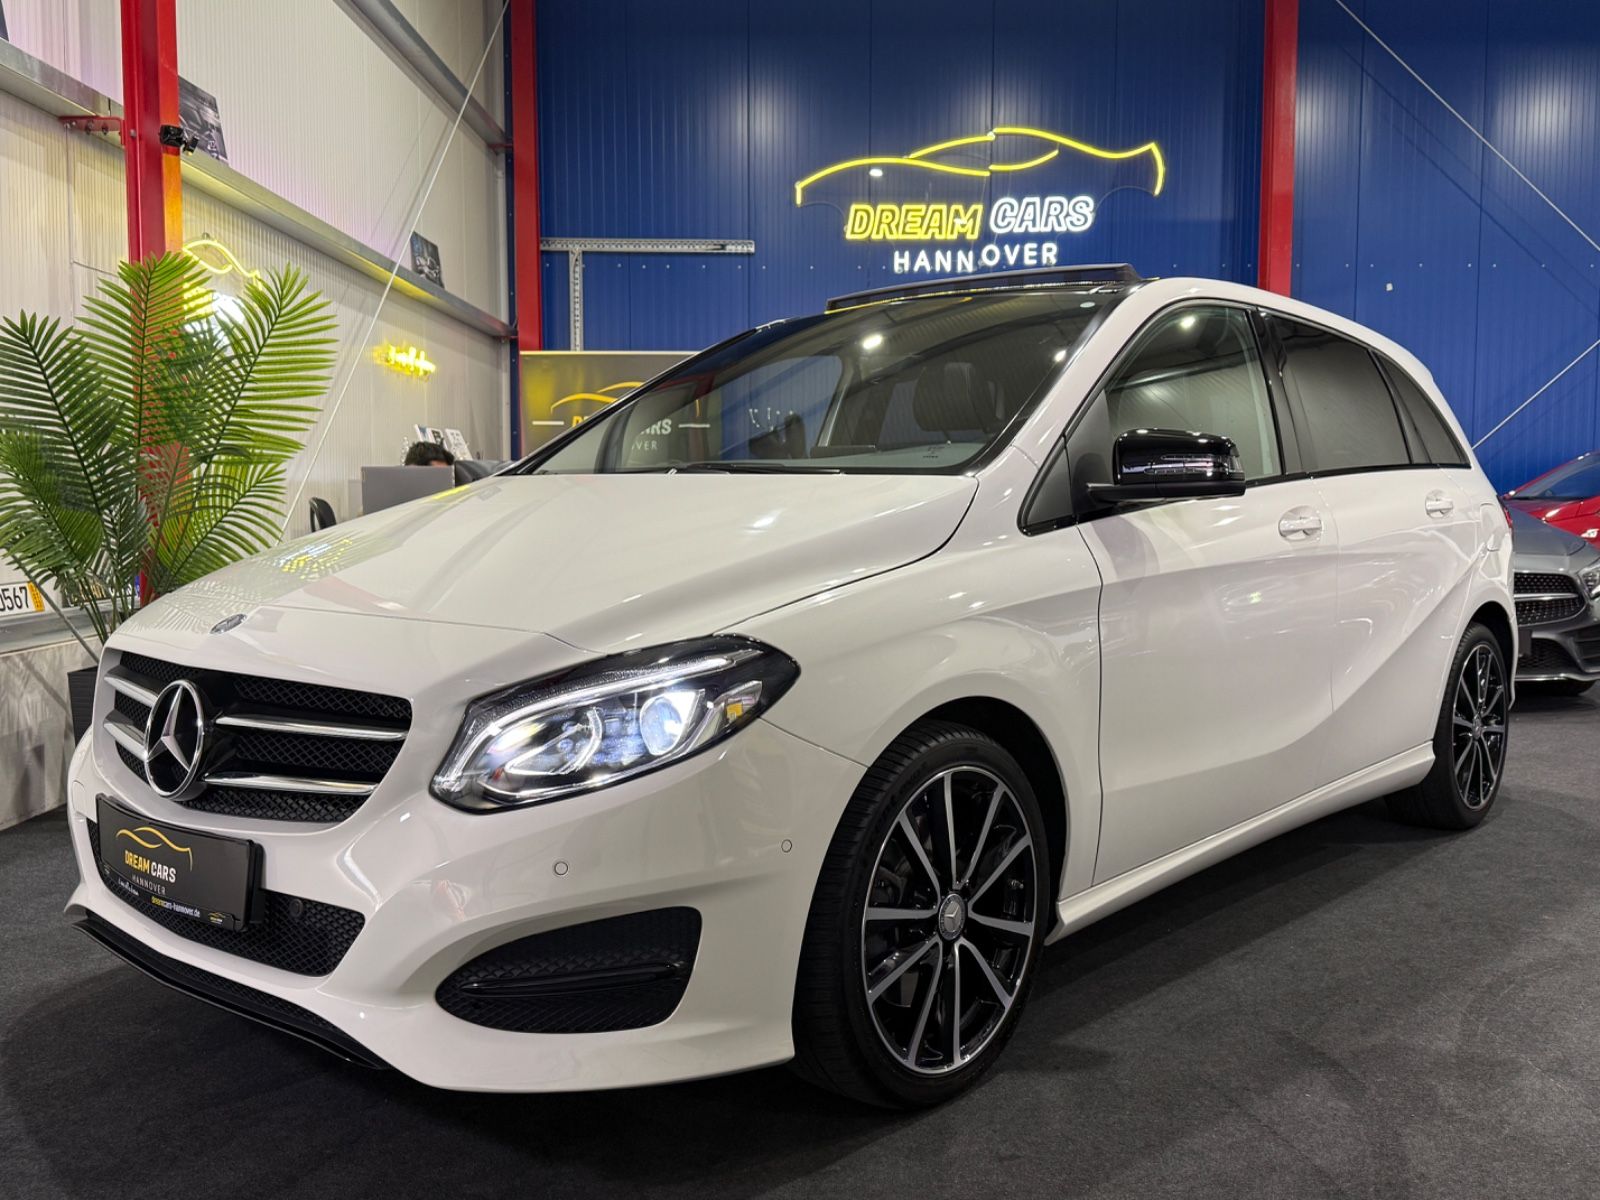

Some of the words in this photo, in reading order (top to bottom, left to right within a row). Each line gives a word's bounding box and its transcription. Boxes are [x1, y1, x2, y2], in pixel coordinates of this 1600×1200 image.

[845, 203, 983, 240] DREAM
[989, 196, 1094, 234] CARS
[893, 243, 1058, 273] HANNOVER
[124, 849, 150, 872] DREAM
[150, 861, 177, 883] CARS
[131, 873, 166, 895] HANNOVER
